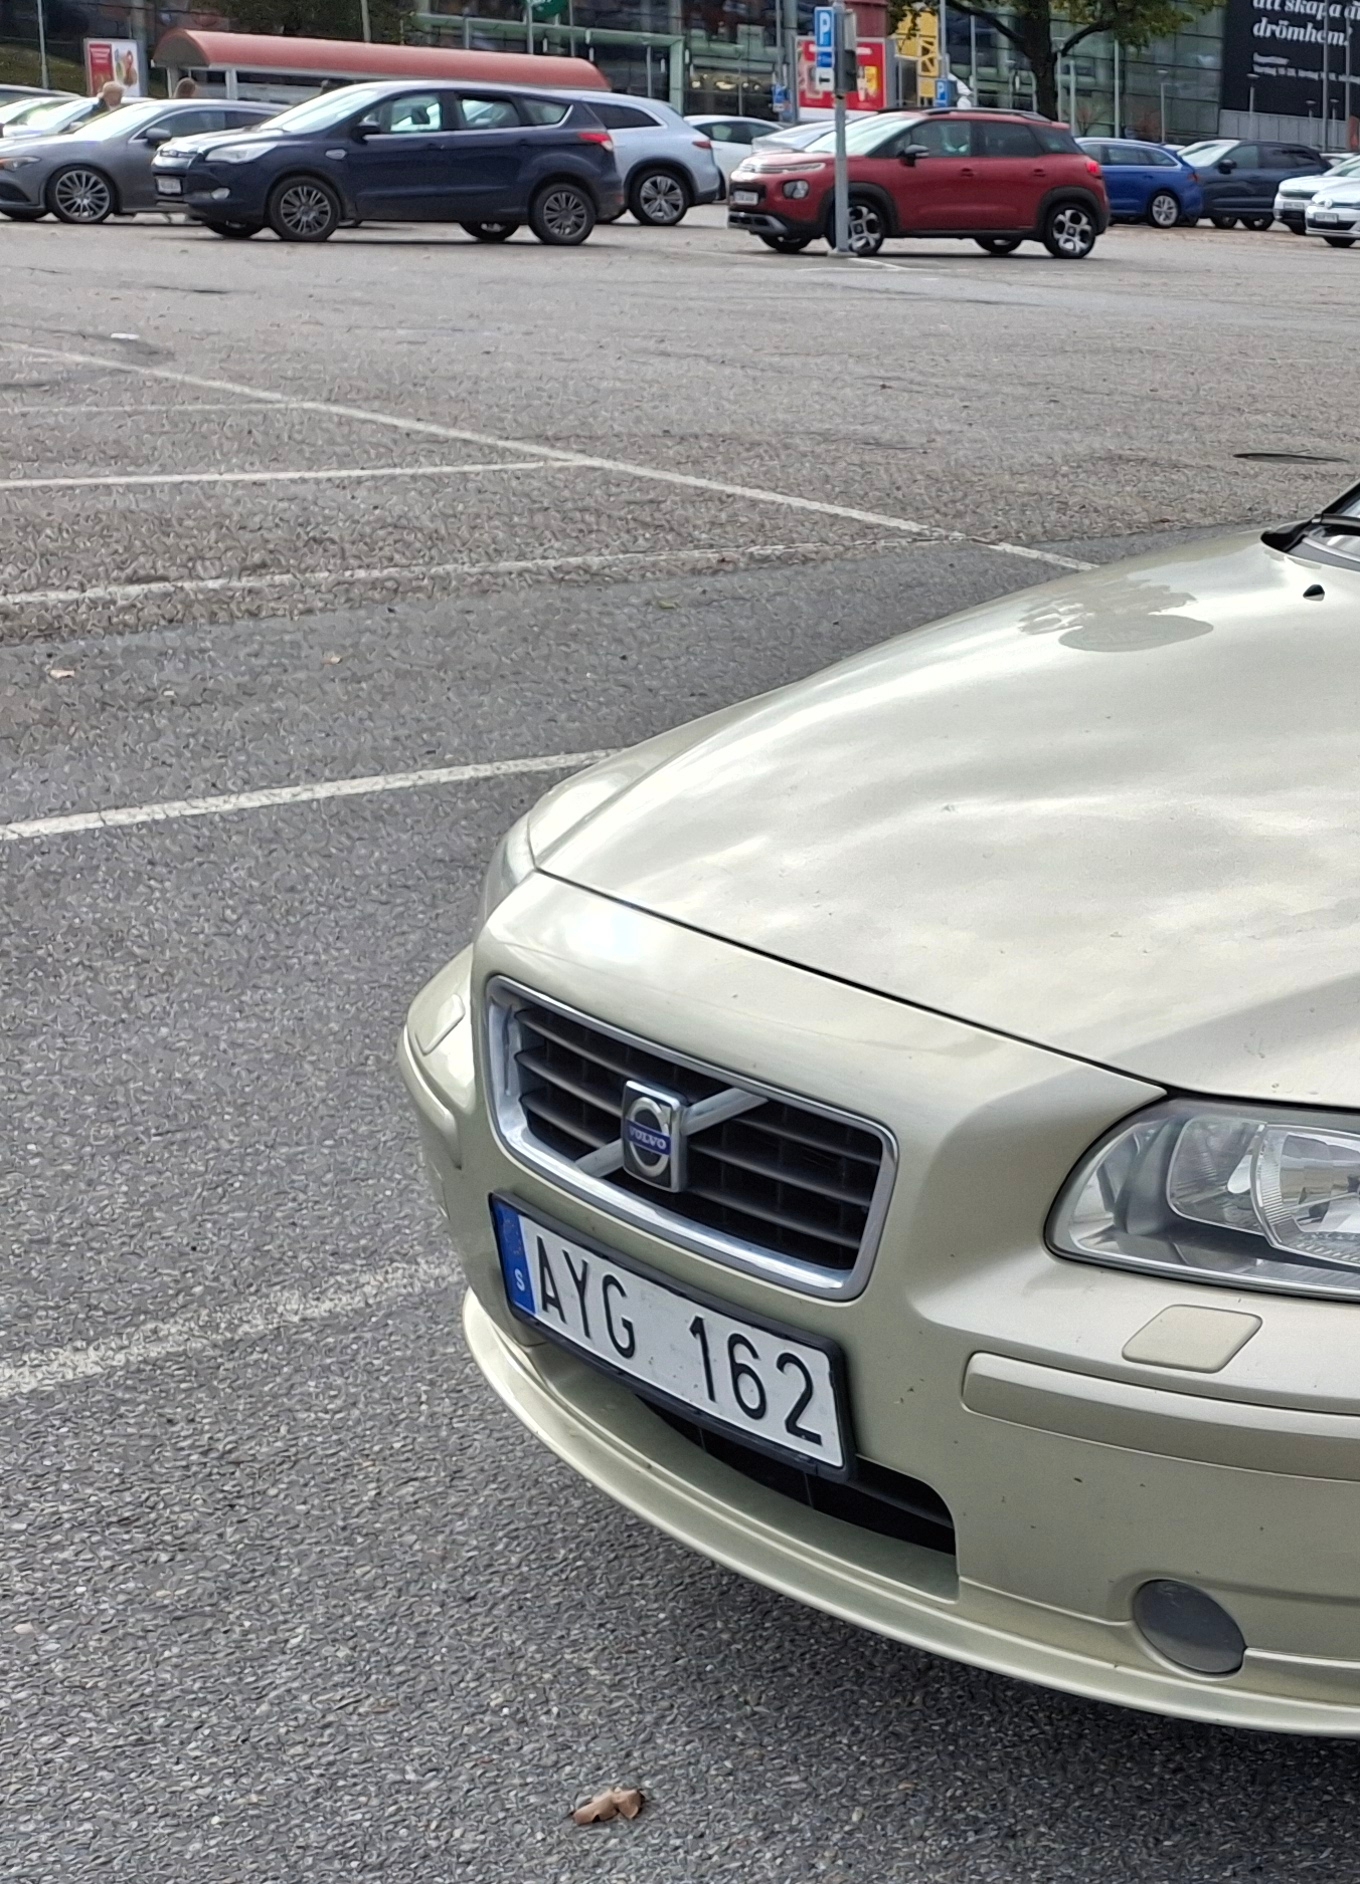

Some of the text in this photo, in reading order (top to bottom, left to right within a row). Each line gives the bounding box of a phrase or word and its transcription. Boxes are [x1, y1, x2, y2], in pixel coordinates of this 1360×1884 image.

[819, 12, 831, 45] P
[629, 1124, 667, 1150] VOLVO
[514, 1268, 526, 1292] S
[536, 1235, 823, 1446] AYG 162
